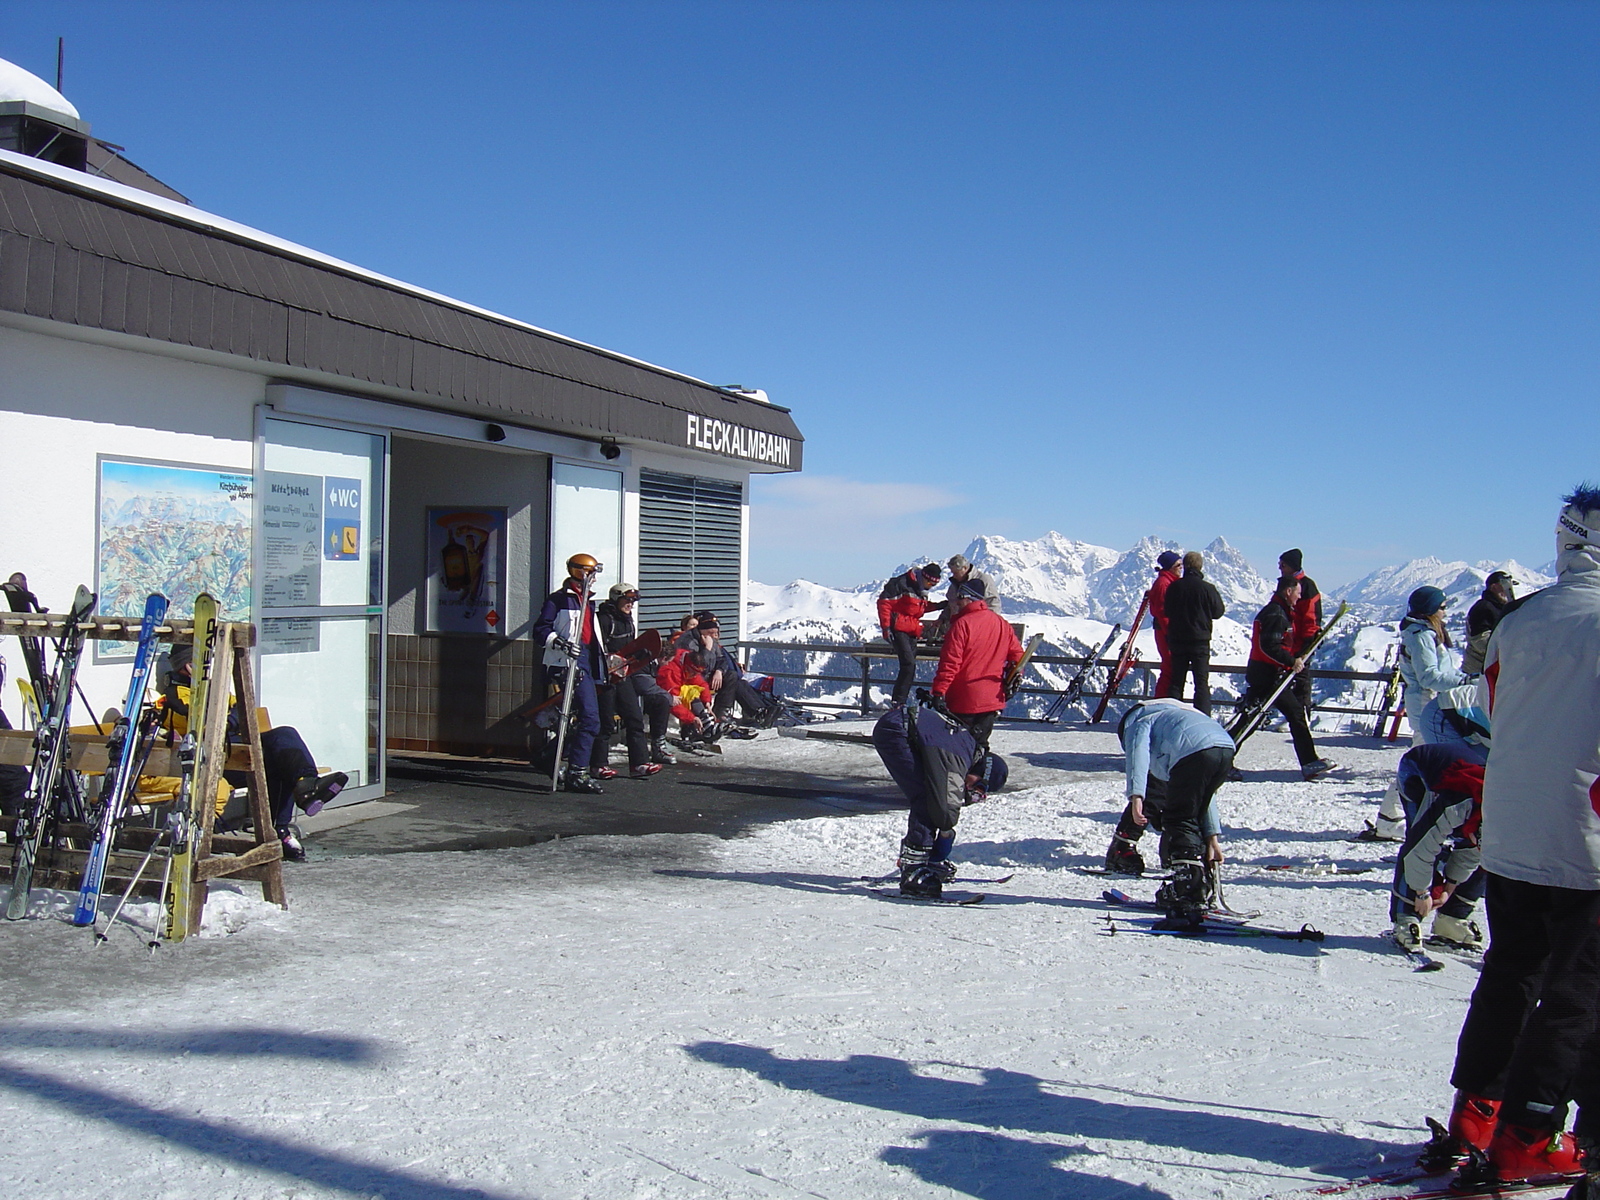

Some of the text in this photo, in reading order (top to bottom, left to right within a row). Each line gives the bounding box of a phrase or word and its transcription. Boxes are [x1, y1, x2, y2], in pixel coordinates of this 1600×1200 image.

[687, 414, 791, 466] FLECKALMBAHN
[338, 488, 359, 508] WC
[1560, 515, 1588, 539] CARRERA
[144, 608, 163, 667] ATOIC
[201, 618, 217, 681] HEAD
[166, 893, 175, 939] HEAD
